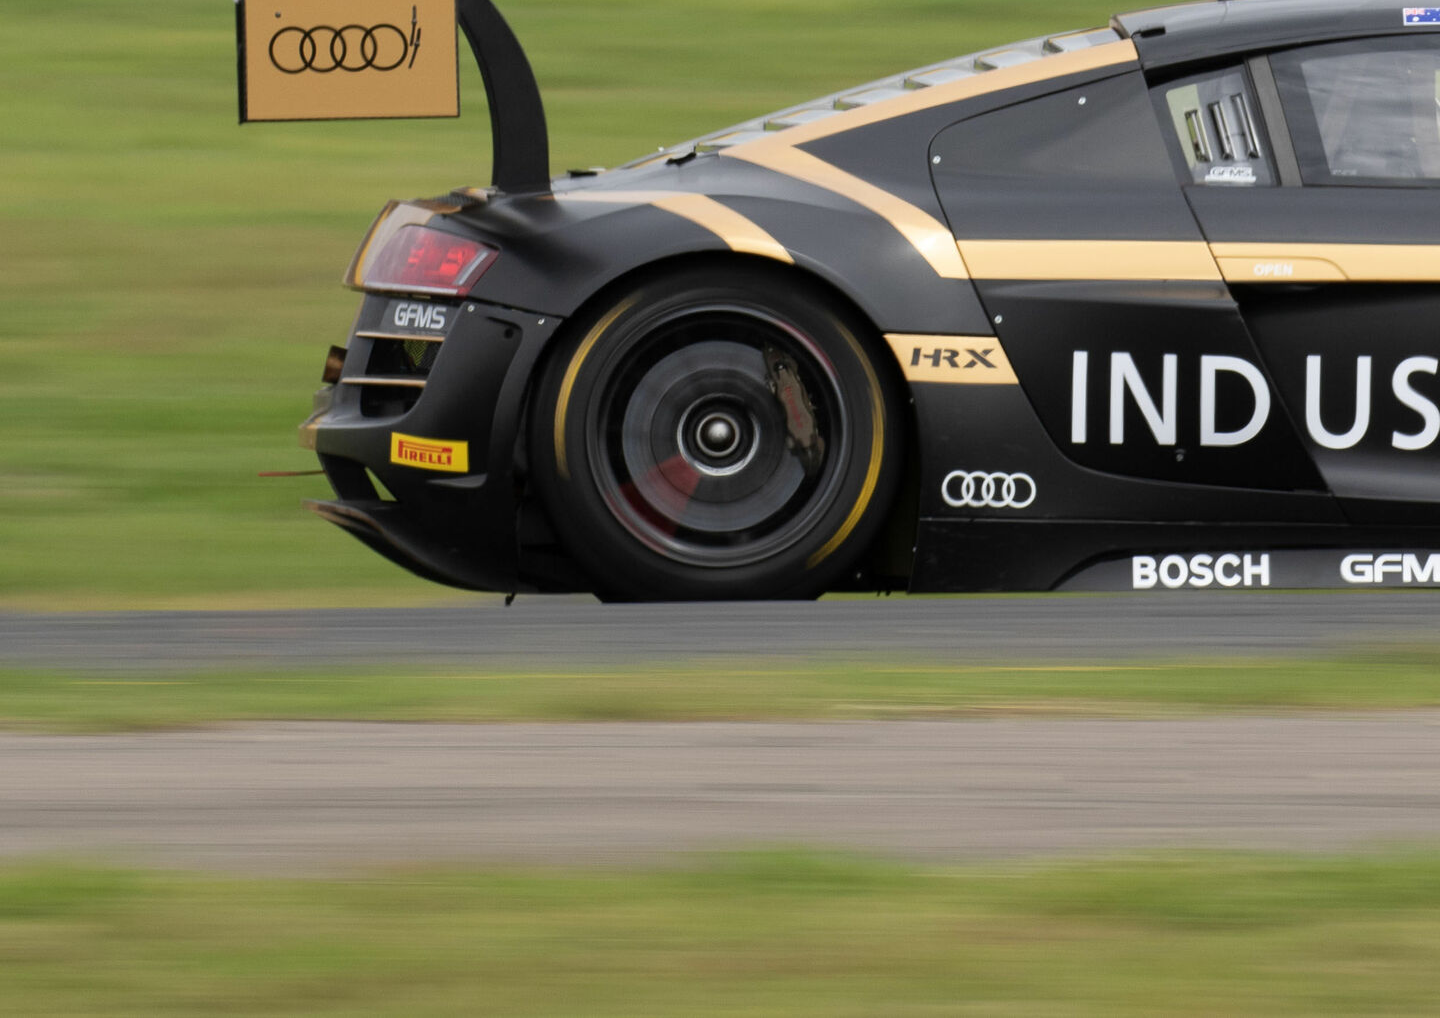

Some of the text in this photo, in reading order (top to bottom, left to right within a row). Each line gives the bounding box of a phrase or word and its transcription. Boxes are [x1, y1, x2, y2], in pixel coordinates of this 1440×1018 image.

[1253, 263, 1293, 277] OPEN
[394, 303, 447, 329] GFMS
[910, 348, 997, 368] HRX
[398, 440, 452, 465] PIRELLI
[1132, 553, 1270, 589] BOSCH
